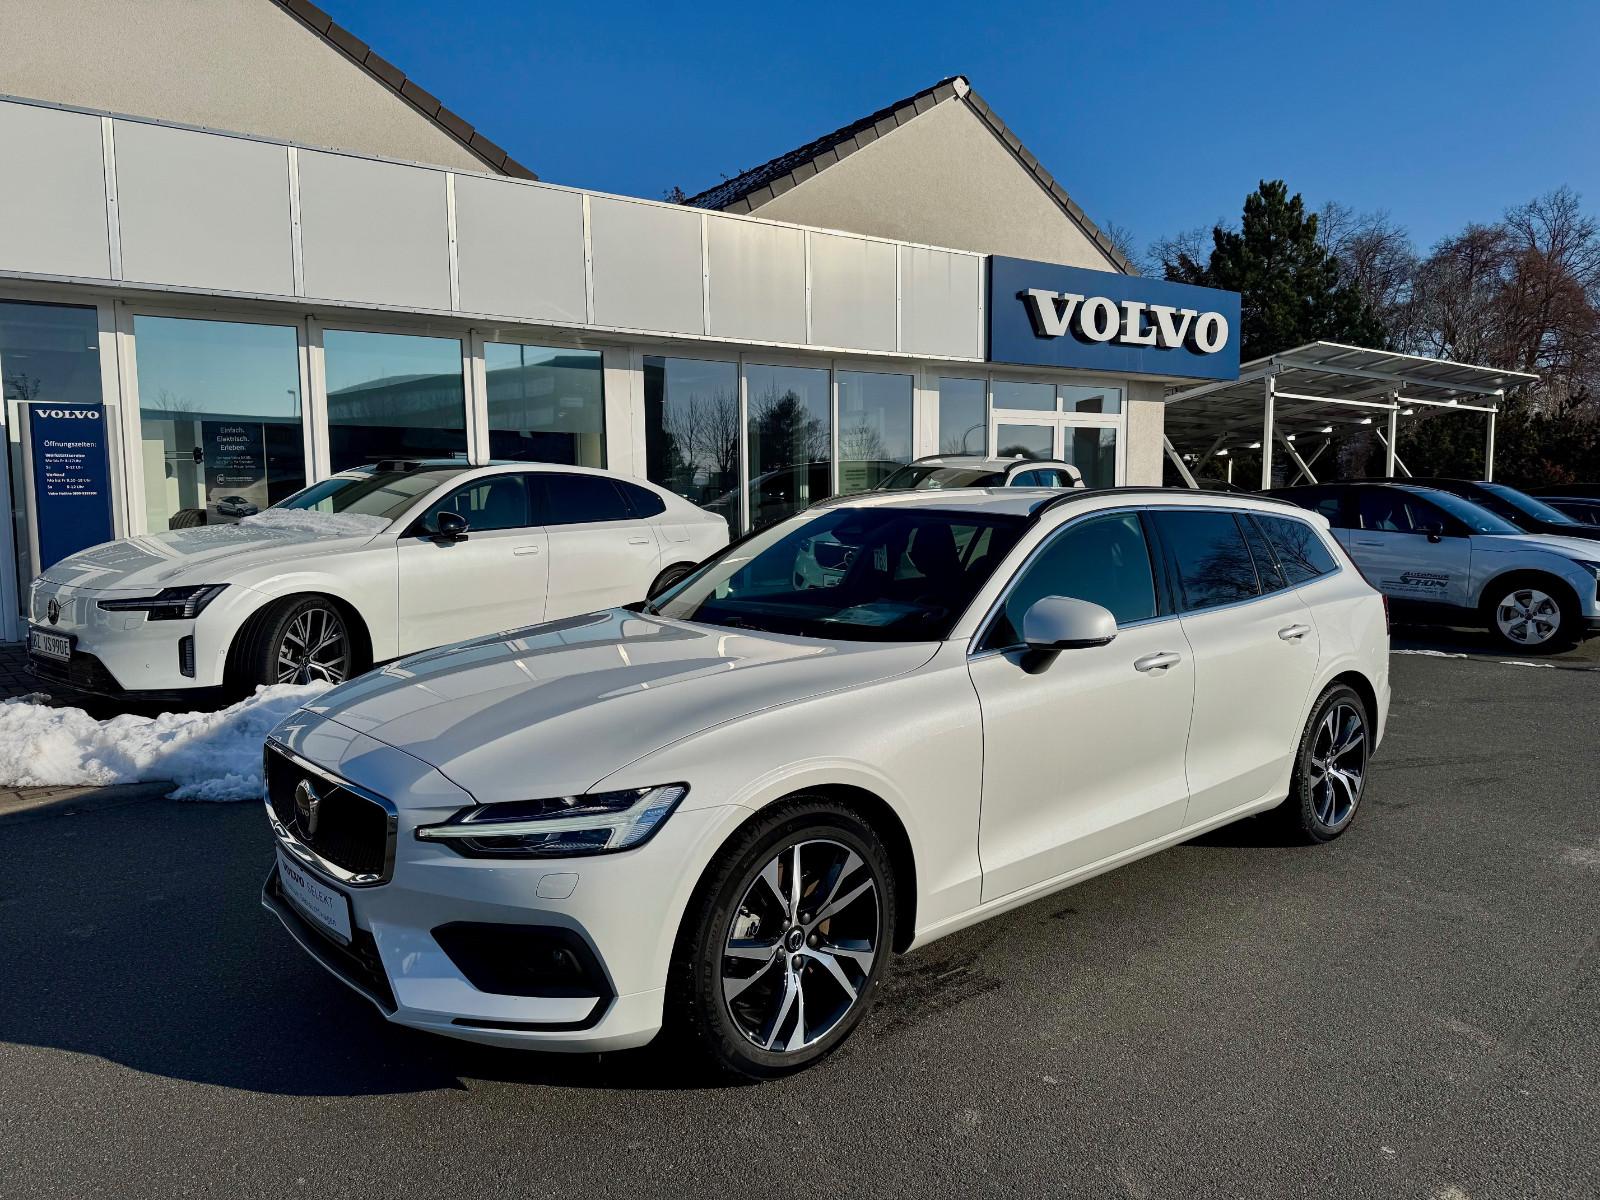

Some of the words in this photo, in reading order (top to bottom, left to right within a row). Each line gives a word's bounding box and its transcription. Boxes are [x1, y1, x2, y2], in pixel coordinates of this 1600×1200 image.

[1027, 288, 1229, 354] VOLVO
[35, 409, 100, 420] VOLVO
[220, 426, 245, 434] Einfach.
[43, 440, 97, 449] Öffnungszeiten:
[281, 858, 305, 887] VOLVO
[306, 881, 333, 908] SELEKT
